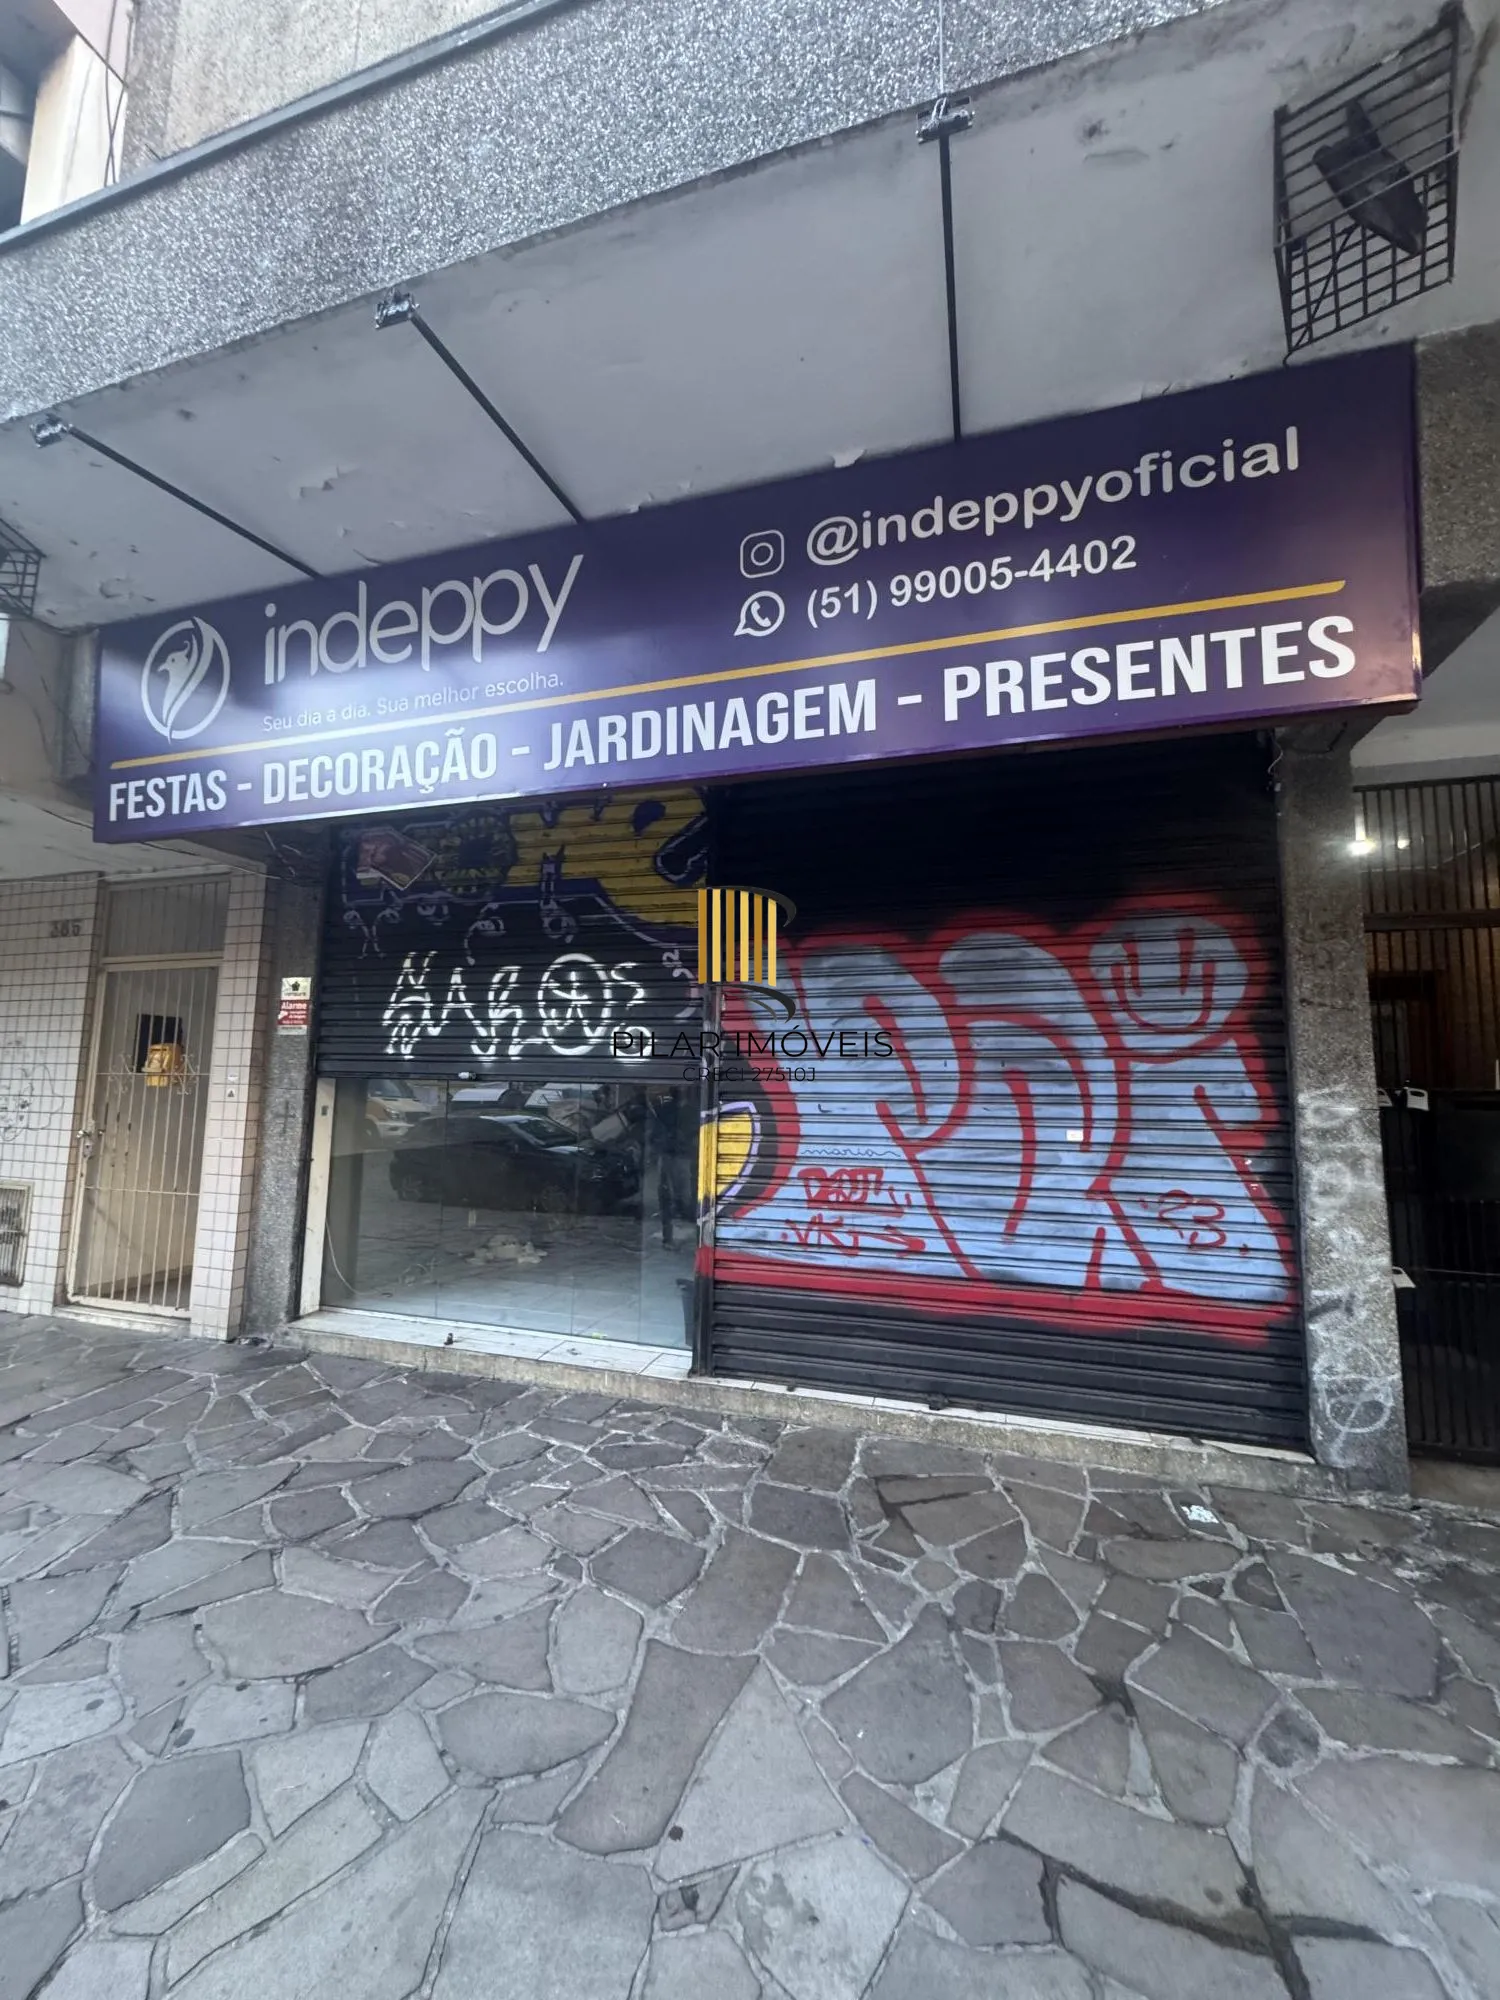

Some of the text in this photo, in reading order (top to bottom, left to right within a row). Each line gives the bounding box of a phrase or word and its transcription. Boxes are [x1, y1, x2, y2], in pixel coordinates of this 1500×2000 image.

[806, 426, 1299, 566] @indeppyoficial
[263, 554, 584, 685] indeppy
[806, 535, 1137, 628] (51) 99005-4402
[108, 769, 228, 822] FESTAS
[263, 727, 498, 805] DECORAÇÃO
[543, 679, 877, 772] JARDINAGEM
[943, 615, 1356, 722] PRESENTES
[262, 671, 564, 732] Seu dia a dia. Sua melhor escolha.
[281, 1001, 307, 1010] Alarme
